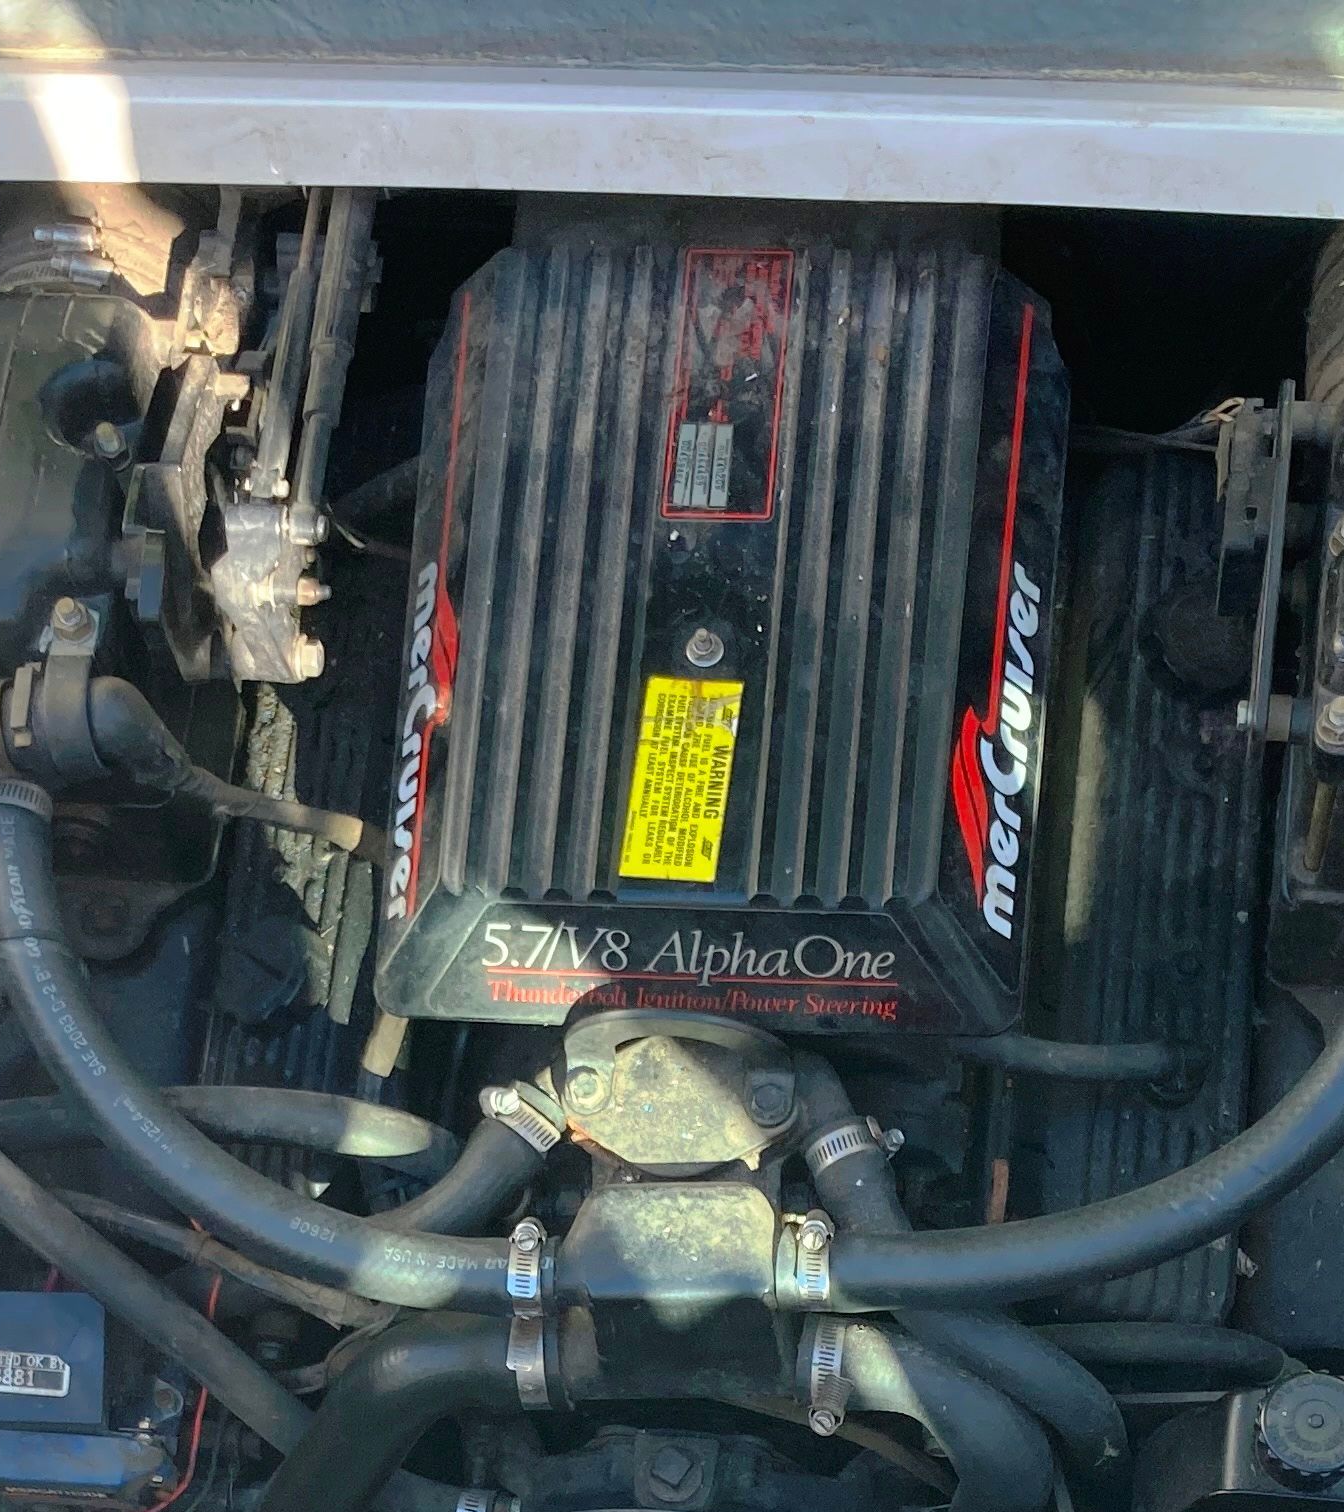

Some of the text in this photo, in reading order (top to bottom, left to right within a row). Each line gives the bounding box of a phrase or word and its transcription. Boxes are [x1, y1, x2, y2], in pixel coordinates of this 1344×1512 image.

[677, 696, 687, 713] FUEL
[660, 736, 671, 755] FUEL
[679, 742, 690, 767] CAUSE
[702, 734, 712, 752] FUEL
[645, 753, 658, 777] LEAST
[665, 752, 678, 783] INSPECT
[689, 754, 698, 768] USE
[651, 761, 665, 794] SYSTEM
[687, 773, 696, 783] OF
[695, 781, 705, 797] FIRE
[704, 746, 729, 819] WARNING
[650, 800, 660, 816] FOR
[661, 786, 673, 817] SYSTEM
[668, 772, 685, 832] DETERIORATION
[681, 788, 693, 822] ALCOHOL
[692, 802, 701, 818] AND
[645, 822, 656, 847] LEAKS
[667, 837, 675, 846] OF
[685, 824, 698, 867] EXPLOSION
[642, 853, 651, 864] OR
[663, 851, 673, 865] THE
[674, 828, 687, 866] MODIFIED
[487, 979, 898, 1021] Thunderbolt Ignition/Power Steering
[58, 1014, 89, 1049] 20R3
[81, 1047, 107, 1077] SAE
[435, 1253, 479, 1270] MADE
[27, 1355, 44, 1369] OK
[48, 1356, 66, 1370] BY
